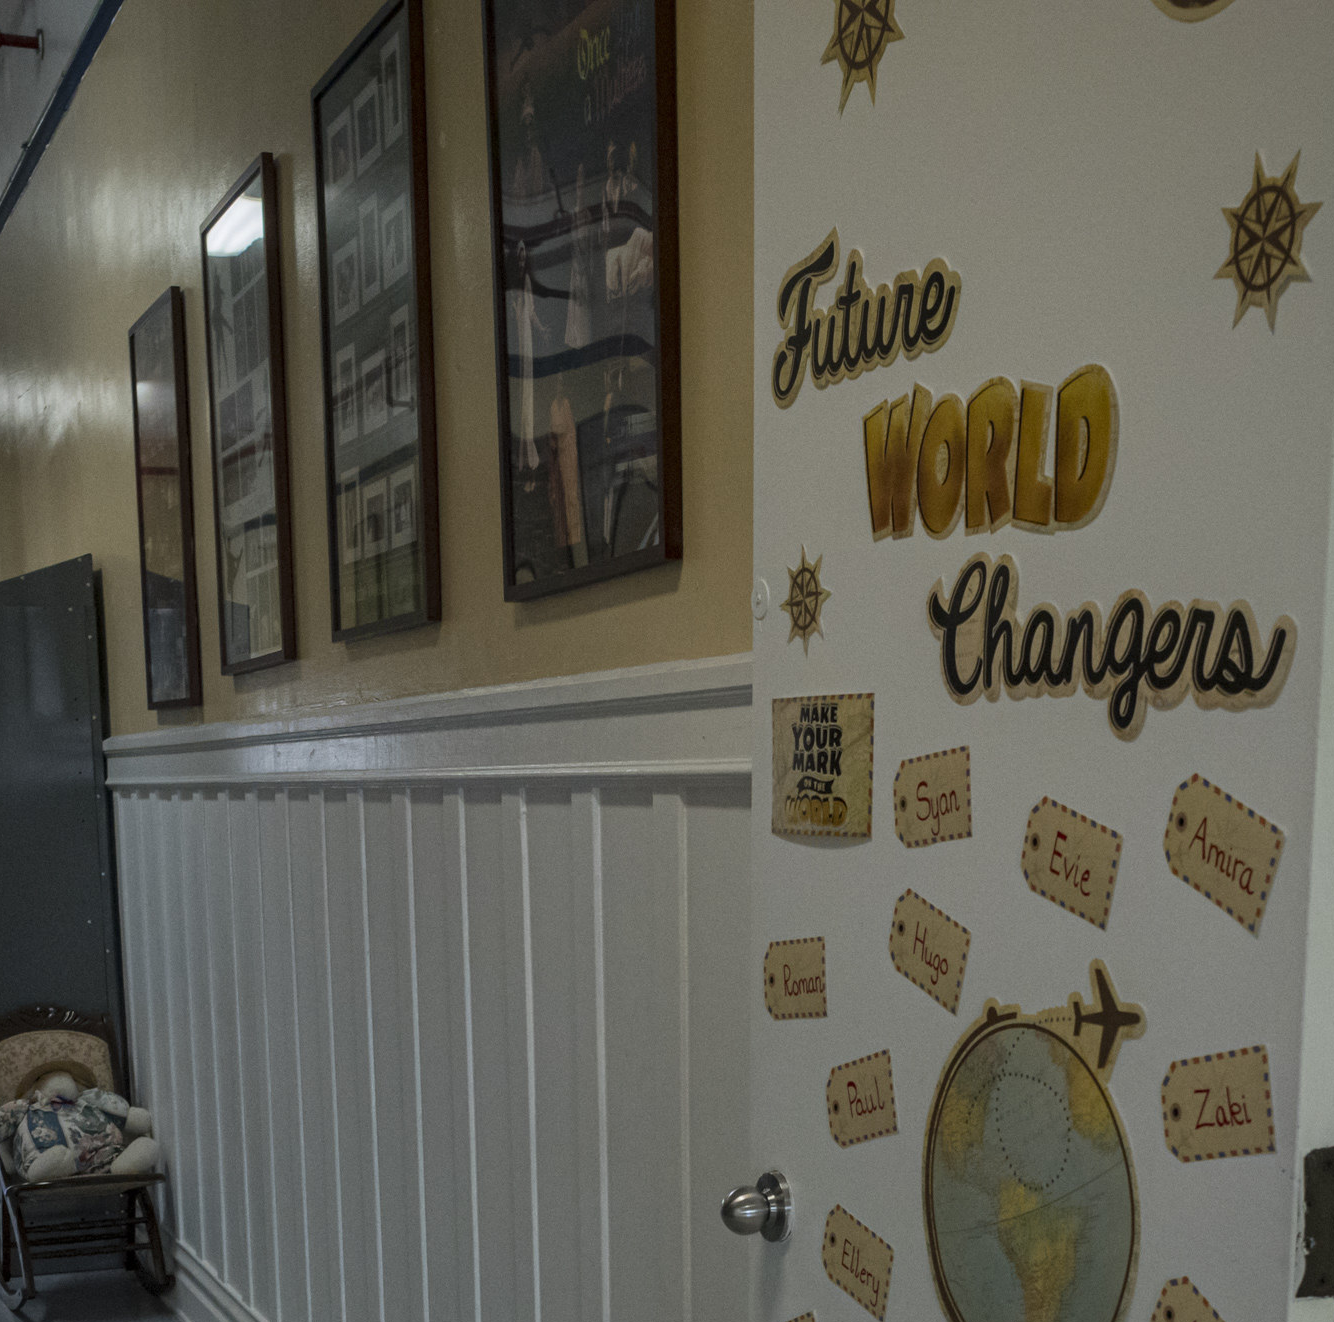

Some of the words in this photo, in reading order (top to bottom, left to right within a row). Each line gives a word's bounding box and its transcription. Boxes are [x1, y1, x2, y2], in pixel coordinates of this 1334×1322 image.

[773, 238, 957, 401] Future
[864, 365, 1116, 539] WORLD
[929, 560, 1286, 731] Changers
[792, 724, 842, 752] YOUR
[800, 704, 838, 724] MAKE
[792, 751, 842, 776] MARK
[814, 781, 826, 792] THE
[915, 781, 961, 836] Syan
[1049, 831, 1092, 897] Evie
[1189, 817, 1255, 895] Amira
[783, 964, 824, 997] Roman
[913, 921, 950, 985] Hugo
[847, 1076, 885, 1118] Paul
[1193, 1086, 1252, 1130] Zaki
[841, 1238, 880, 1308] Ellery
